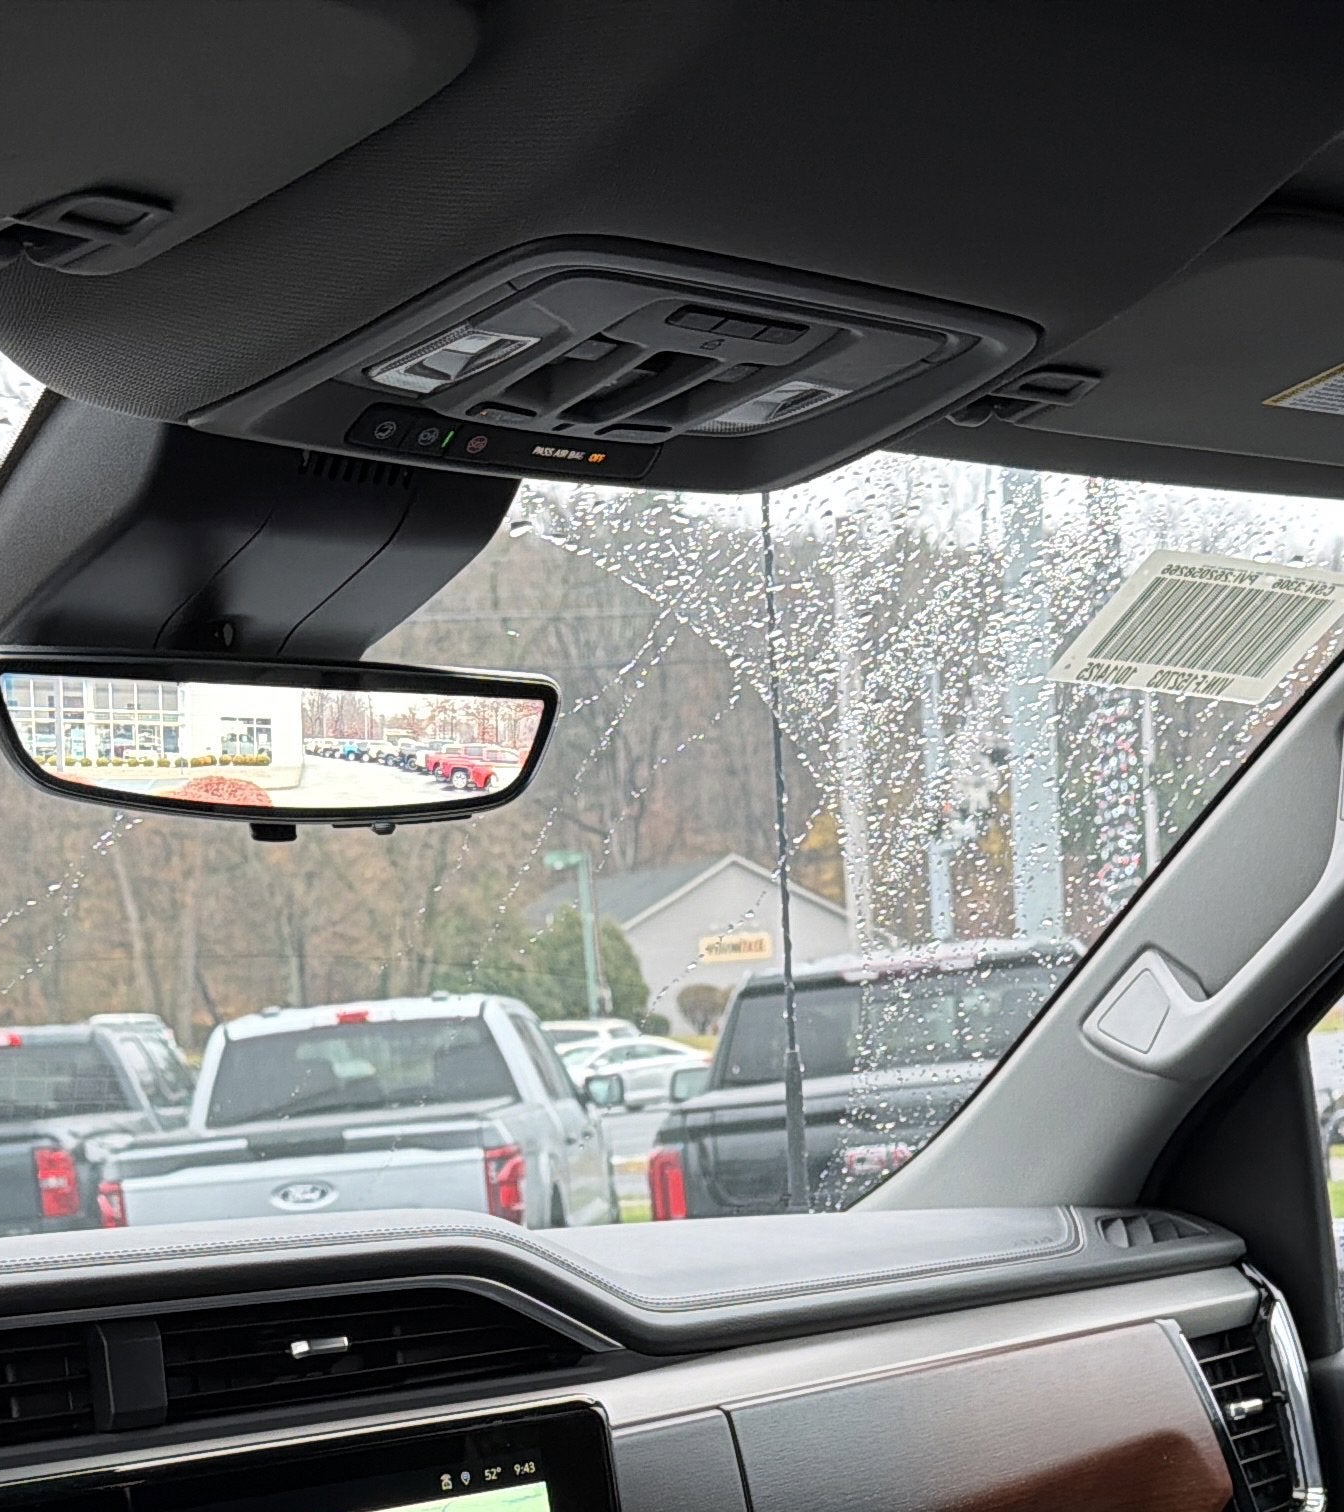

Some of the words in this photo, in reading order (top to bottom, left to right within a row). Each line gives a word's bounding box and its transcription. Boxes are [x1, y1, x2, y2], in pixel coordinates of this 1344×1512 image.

[532, 445, 555, 457] PASS
[588, 453, 606, 463] OFF
[513, 1461, 536, 1476] 9:43
